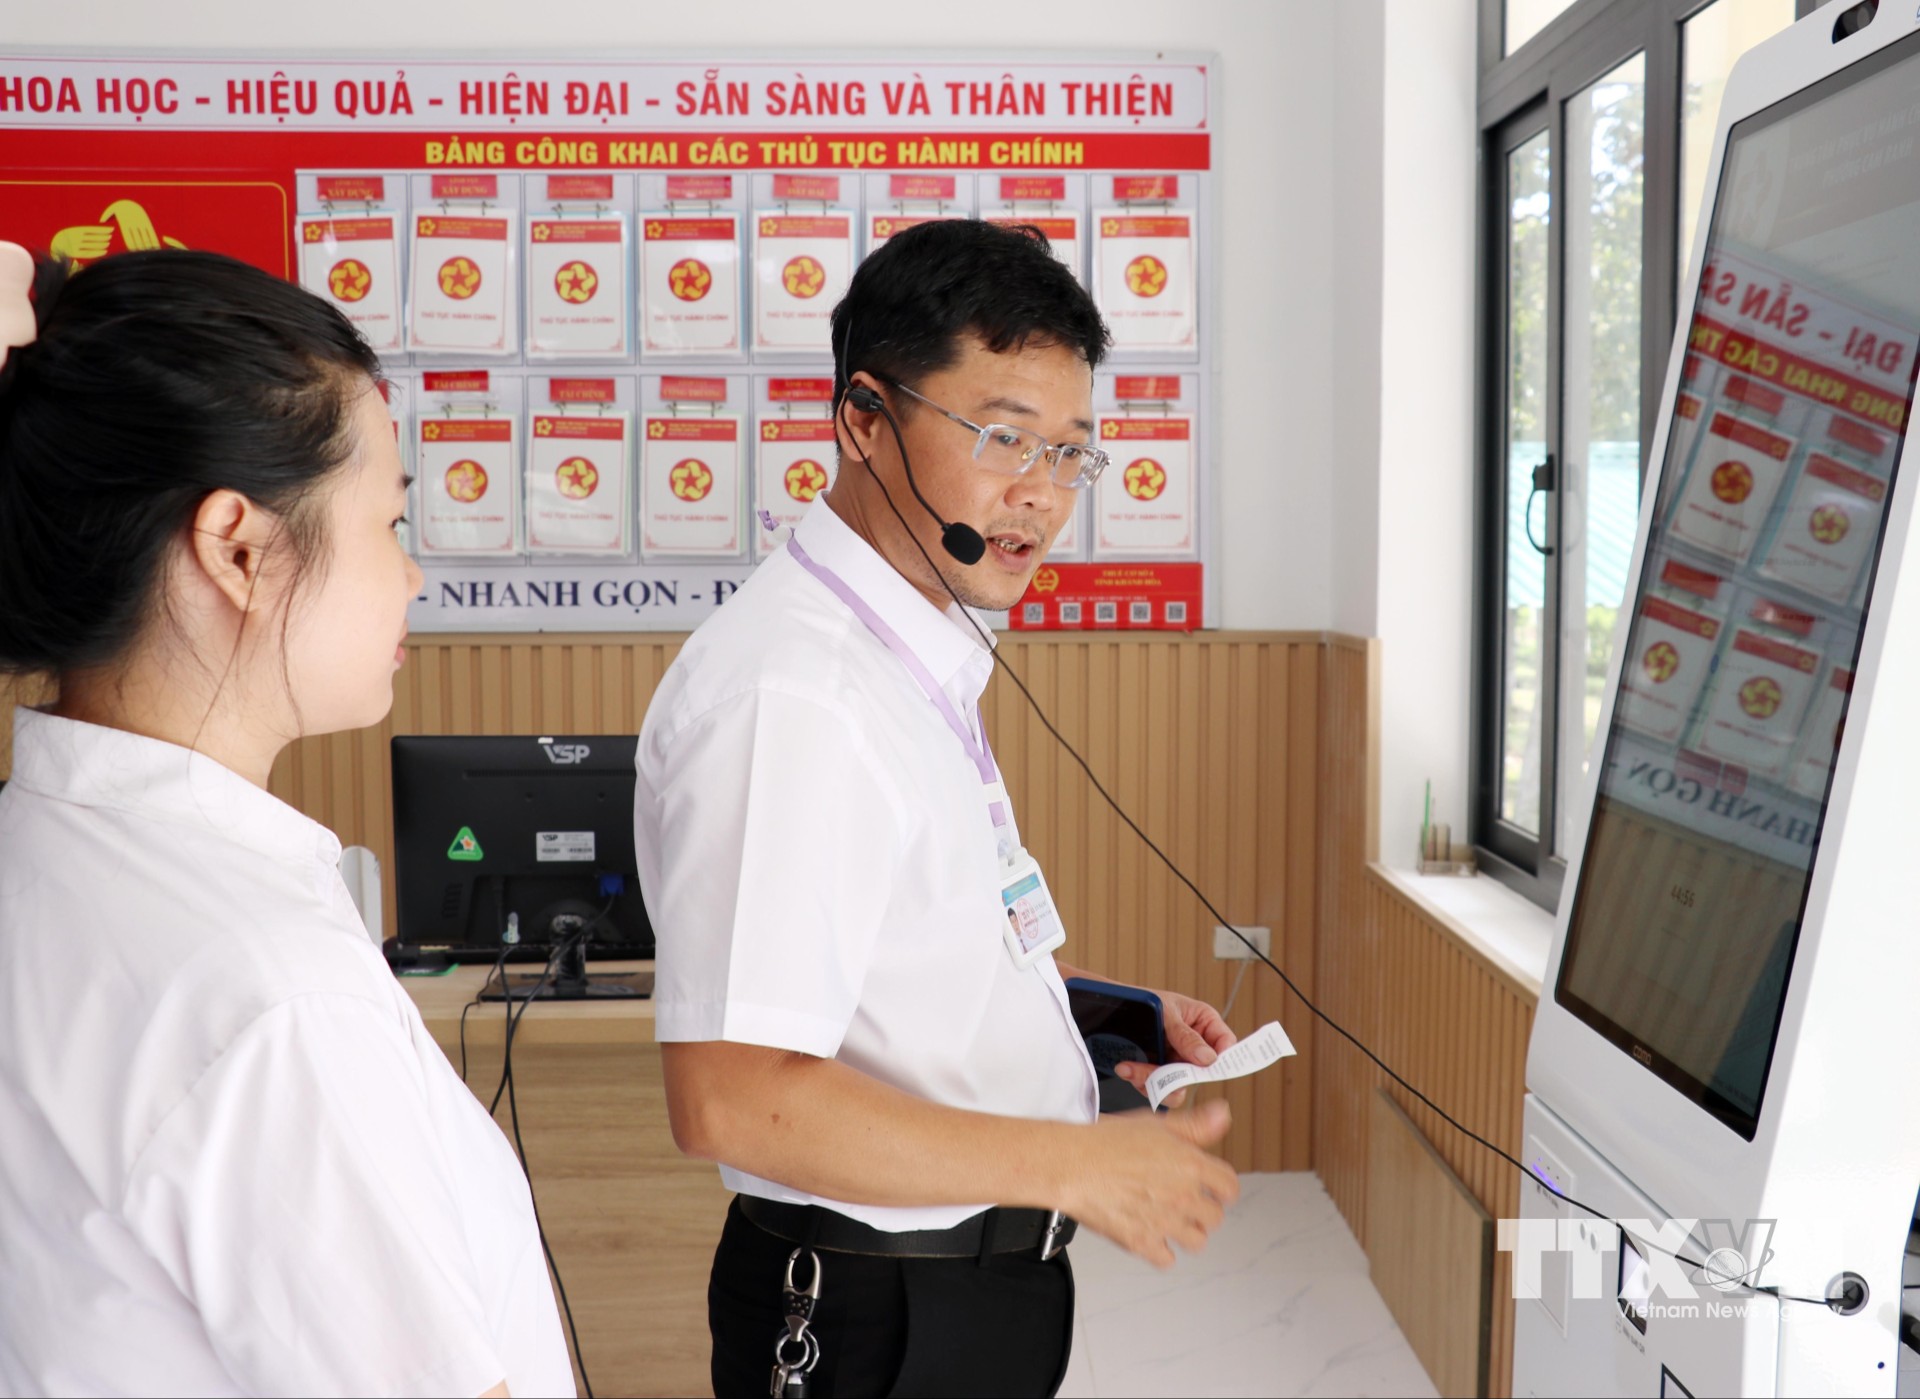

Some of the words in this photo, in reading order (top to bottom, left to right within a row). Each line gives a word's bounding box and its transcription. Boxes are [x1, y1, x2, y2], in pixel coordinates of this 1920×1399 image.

[0, 76, 81, 113] HOA
[95, 78, 178, 122] HỌC
[226, 71, 317, 123] HIỆU
[334, 70, 414, 119] QUẢ
[459, 72, 549, 123] HIỆN
[564, 81, 628, 123] ĐẠI
[675, 69, 750, 116] SẴN
[766, 74, 866, 116] SÀNG
[882, 74, 931, 116] VÀ
[945, 74, 1045, 116] THÂN
[1060, 74, 1172, 124] THIỆN
[426, 136, 504, 164] BẢNG
[516, 137, 598, 164] CÔNG
[609, 142, 678, 164] KHAI
[688, 136, 748, 165] CÁC
[759, 136, 817, 165] THỦ
[828, 142, 887, 168] TỤC
[898, 136, 979, 164] HÀNH
[989, 137, 1084, 165] CHÍNH
[440, 581, 580, 607] NHANH
[593, 580, 678, 614] GỌN
[543, 744, 591, 764] VSP
